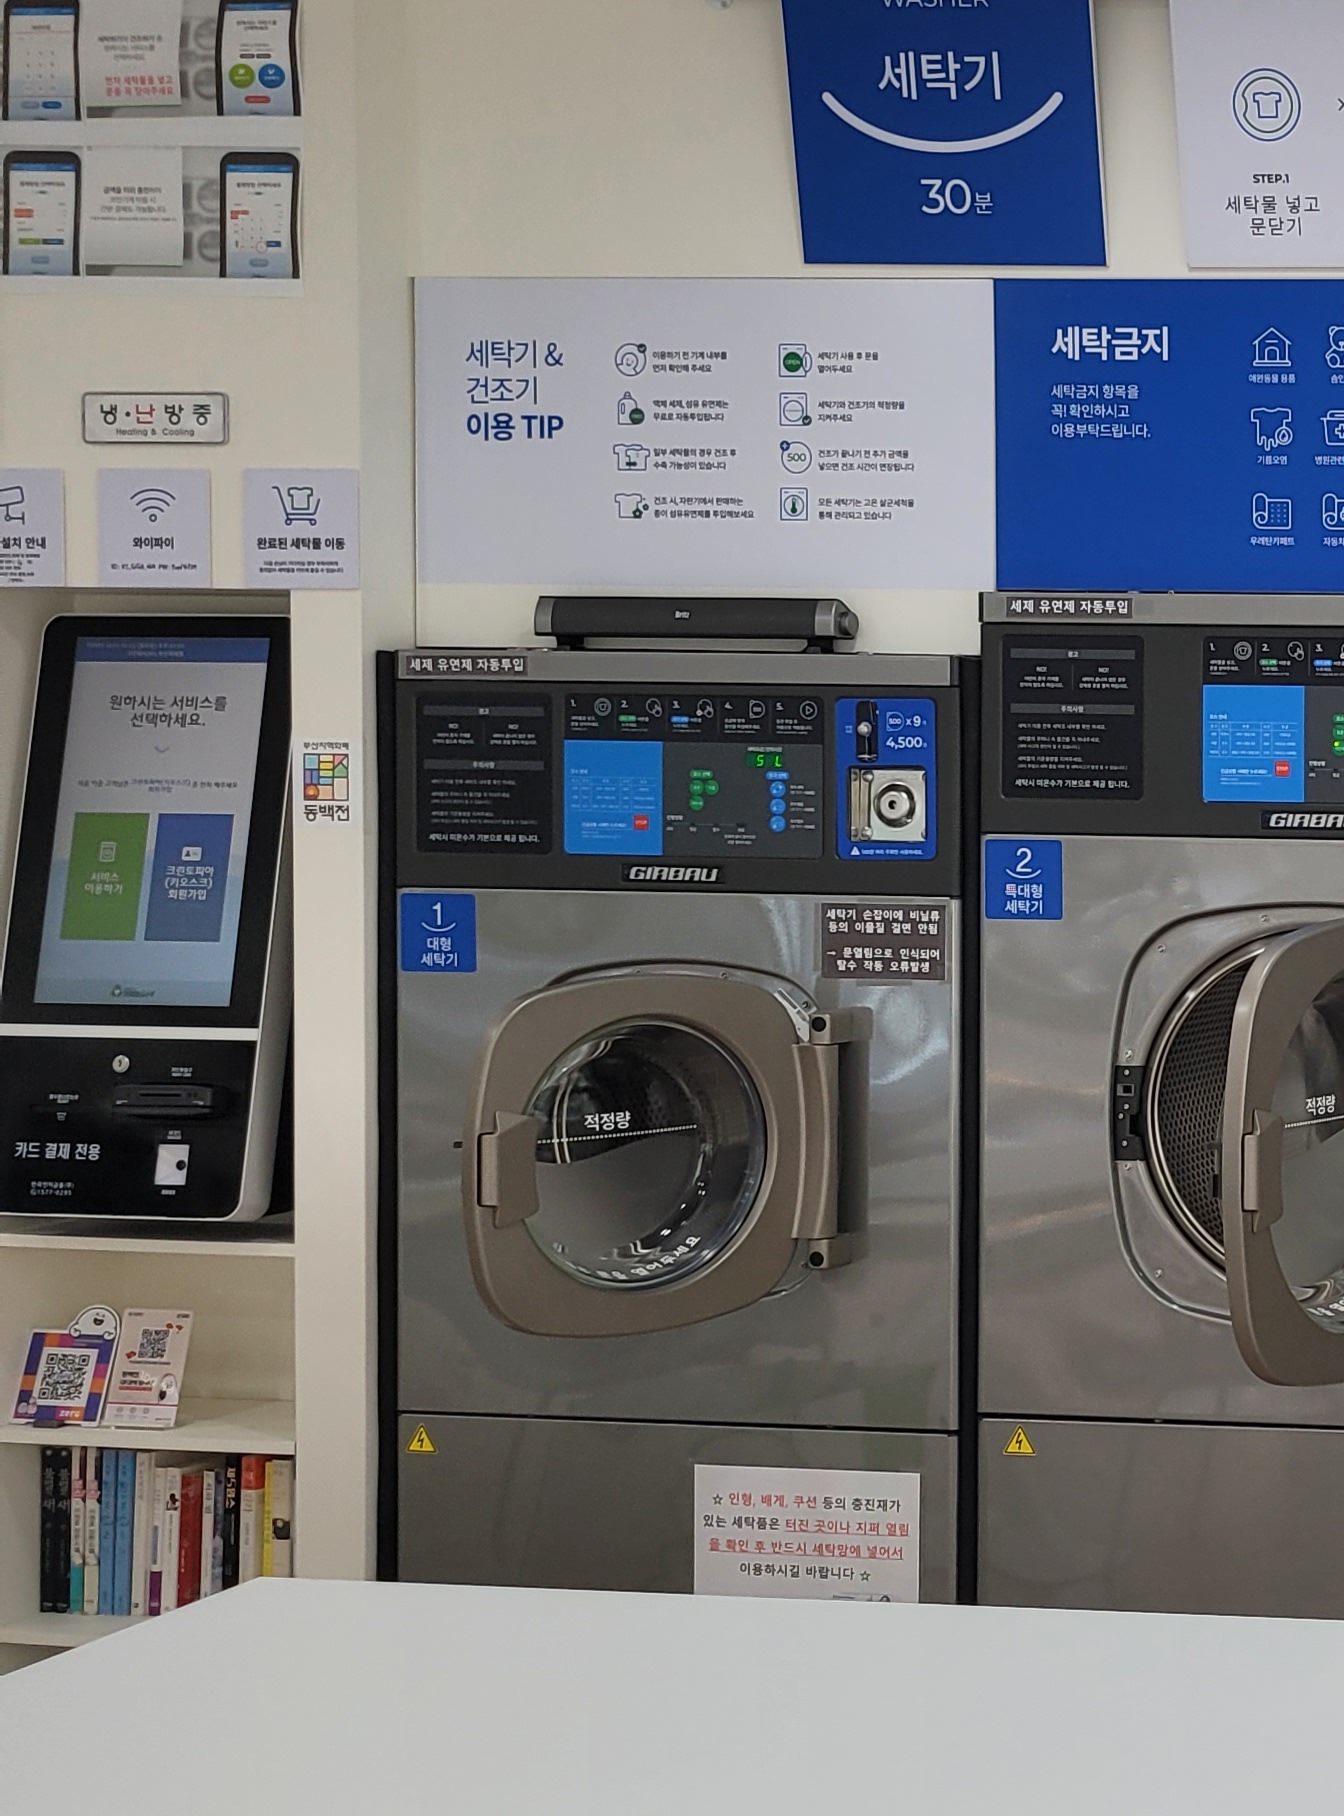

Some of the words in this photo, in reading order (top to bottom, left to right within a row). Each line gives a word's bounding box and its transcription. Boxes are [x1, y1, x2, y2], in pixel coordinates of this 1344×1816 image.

[878, 51, 1001, 100] 세탁기
[1252, 173, 1289, 183] STEP.1
[1225, 195, 1277, 214] 세탁물
[1285, 195, 1320, 214] 넣고
[1250, 216, 1301, 236] 문닫기
[1051, 326, 1168, 361] 세탁금지
[465, 339, 536, 369] 세탁기
[544, 342, 563, 367] &
[466, 376, 537, 405] 건조기
[1051, 383, 1100, 400] 세탁금지
[1101, 383, 1139, 400] 항목을
[1051, 404, 1067, 418] 꼭!
[1069, 403, 1130, 419] 확인하시고
[466, 412, 515, 441] 이용
[520, 415, 564, 439] TIP
[1051, 423, 1151, 438] 이용부탁드립니다.
[133, 535, 176, 549] 와이파이
[257, 537, 289, 552] 완료된
[290, 537, 322, 551] 세탁물
[324, 536, 345, 551] 이동
[303, 804, 349, 822] 동백전
[1014, 847, 1035, 877] 2
[1003, 882, 1044, 901] 특대형
[432, 902, 441, 925] 1
[1005, 898, 1042, 914] 세탁기
[424, 936, 454, 953] 대형
[420, 952, 459, 967] 세탁기
[1305, 1093, 1336, 1116] 적정량
[584, 1111, 632, 1132] 적정량
[14, 1142, 40, 1158] 카드
[45, 1142, 70, 1159] 결제
[75, 1143, 100, 1161] 전용
